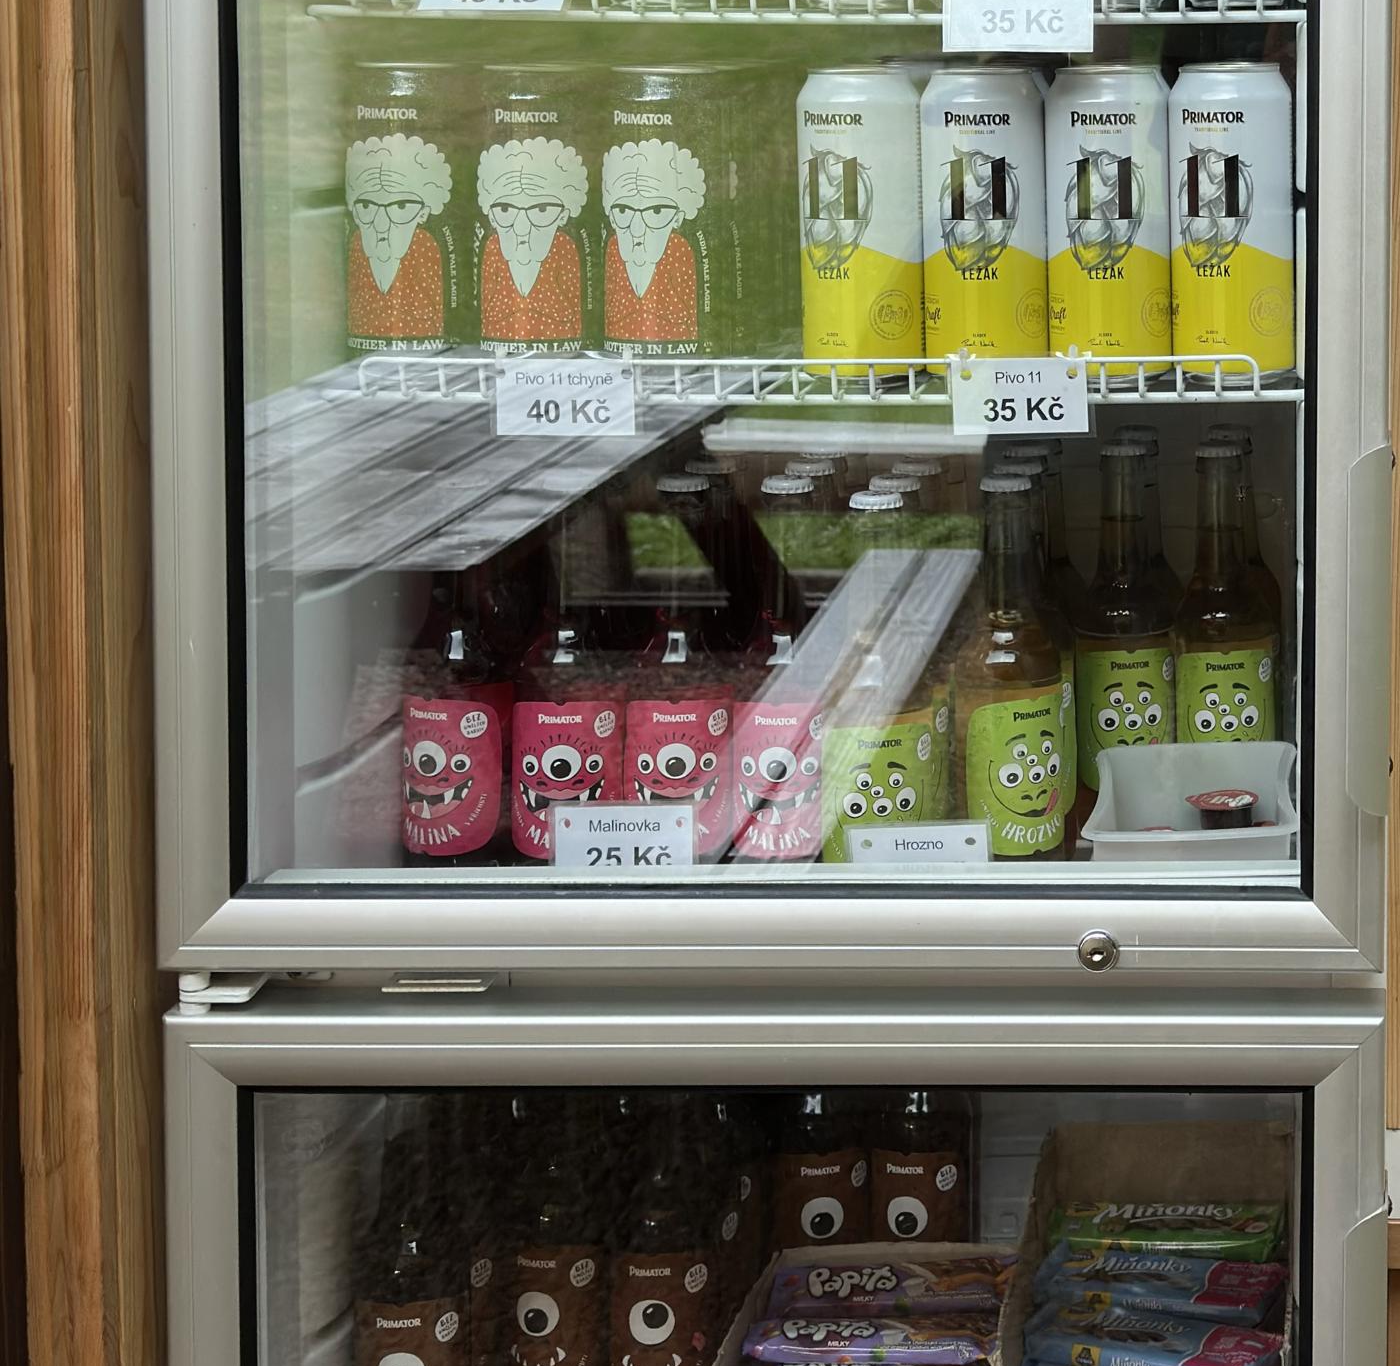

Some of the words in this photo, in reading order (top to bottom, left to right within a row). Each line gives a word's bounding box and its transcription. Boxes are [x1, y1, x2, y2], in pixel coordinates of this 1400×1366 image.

[982, 10, 1014, 33] 35
[1026, 9, 1064, 33] Kč
[696, 231, 707, 259] INDIA
[700, 261, 710, 283] PALE
[962, 265, 998, 280] LEŽÁK
[703, 285, 711, 313] LAGER
[516, 372, 544, 385] Pivo
[550, 373, 562, 385] 11
[568, 373, 613, 388] tchyně
[996, 372, 1024, 383] Pivo
[1029, 371, 1040, 383] 11
[527, 400, 560, 423] 40
[571, 399, 610, 423] Kč
[984, 399, 1016, 422] 35
[1027, 397, 1064, 420] Kč
[589, 819, 660, 832] Malinovka
[1001, 815, 1062, 845] HROZNO
[587, 847, 621, 866] 25
[632, 845, 672, 866] Kč
[895, 839, 943, 850] Hrozno
[807, 1267, 898, 1298] Papita
